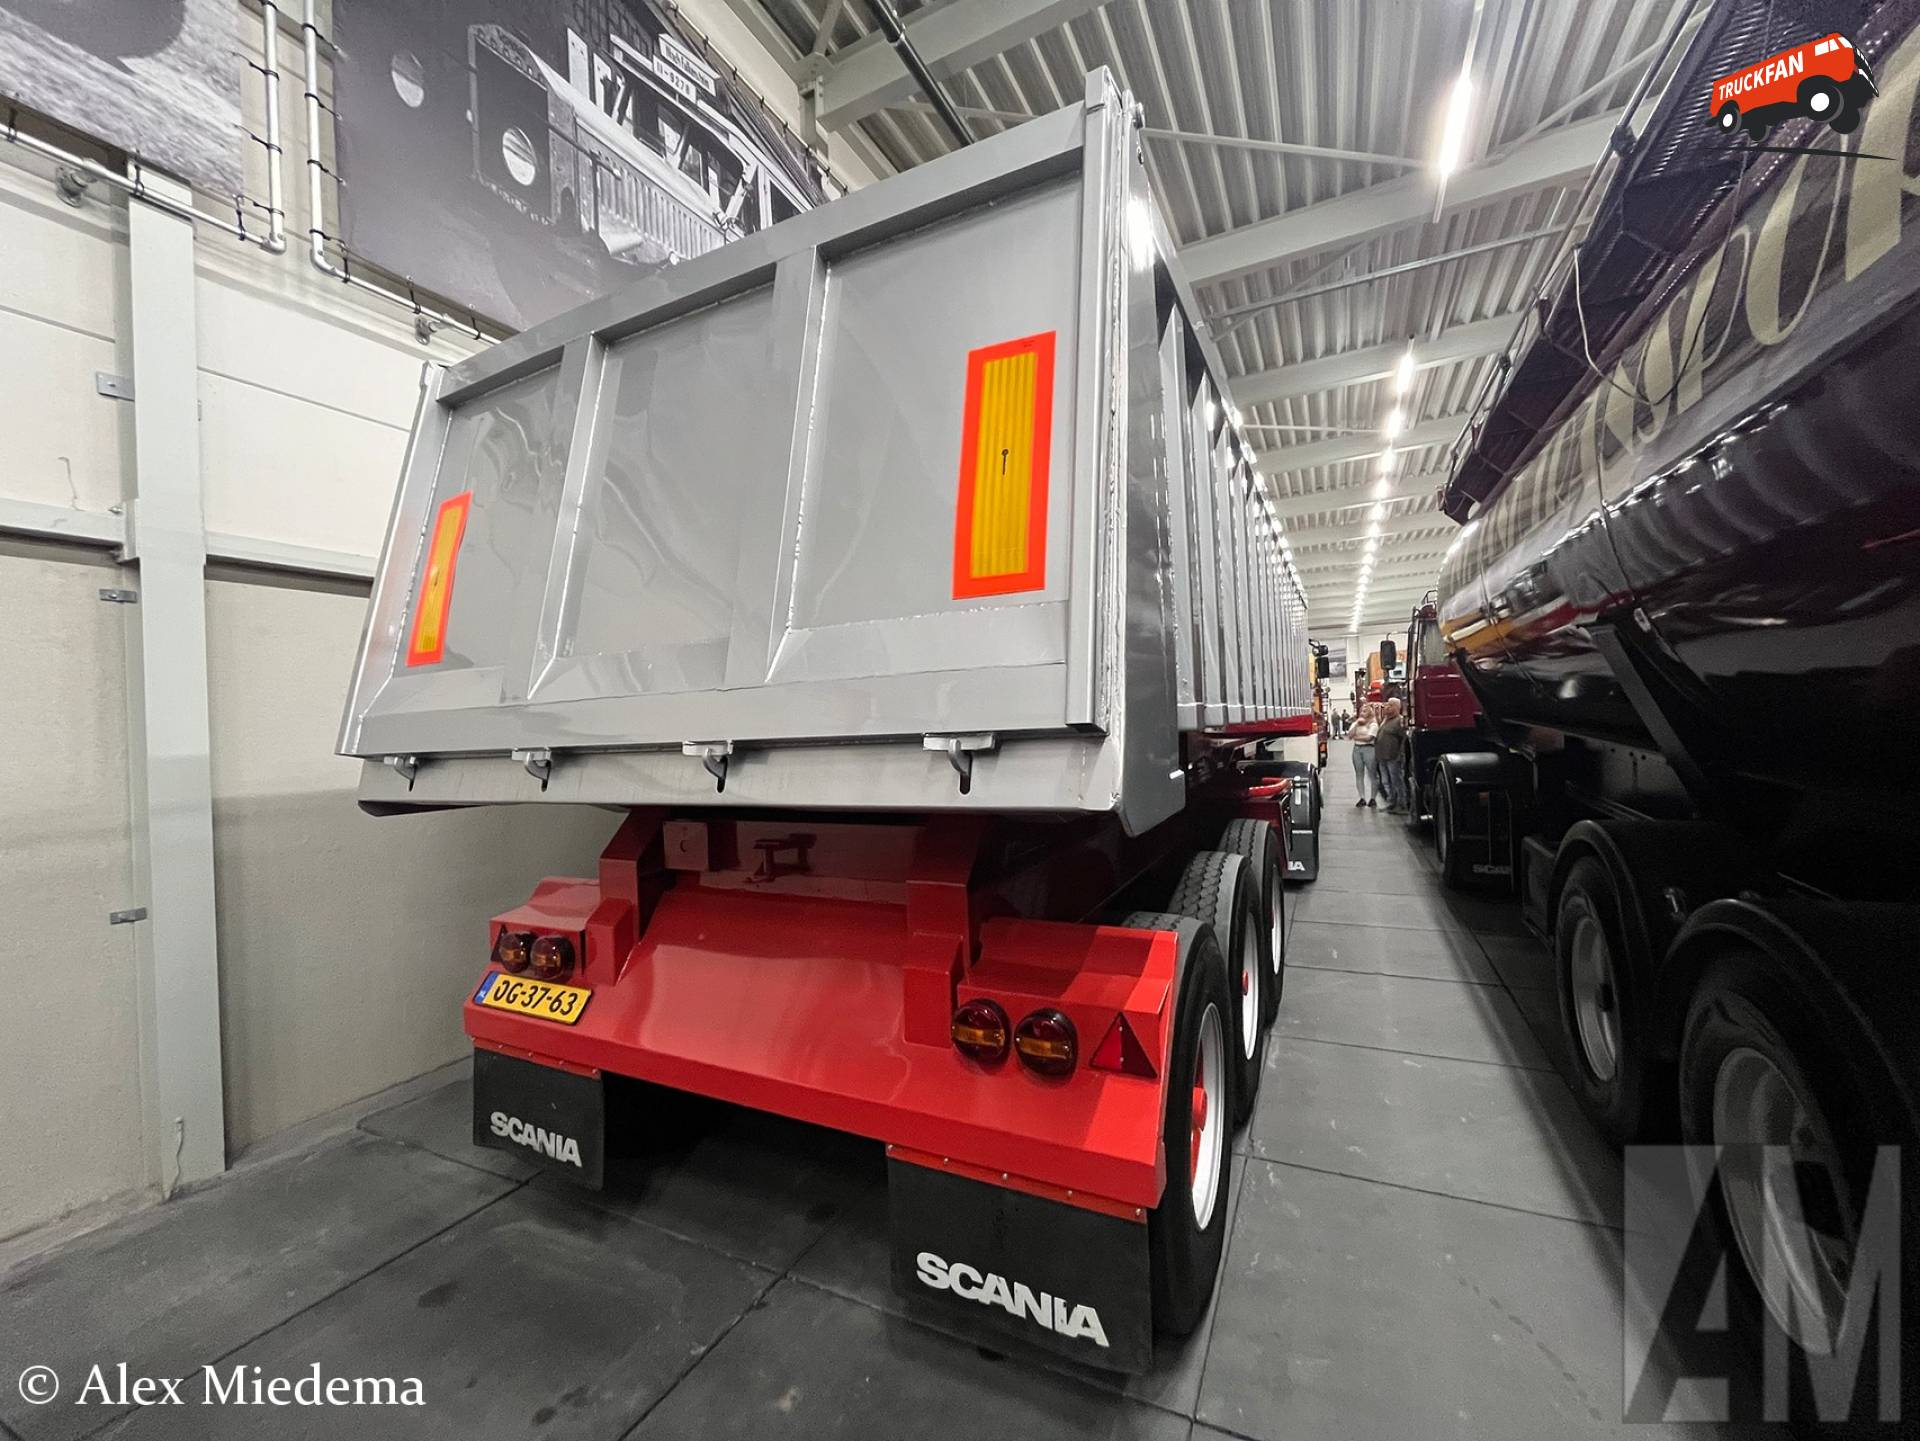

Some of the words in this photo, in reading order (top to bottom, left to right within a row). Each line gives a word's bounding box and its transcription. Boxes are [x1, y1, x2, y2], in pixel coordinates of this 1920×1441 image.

[493, 980, 578, 1016] OG-37-63
[490, 1111, 582, 1168] SCANIA
[916, 1252, 1110, 1347] SCANIA
